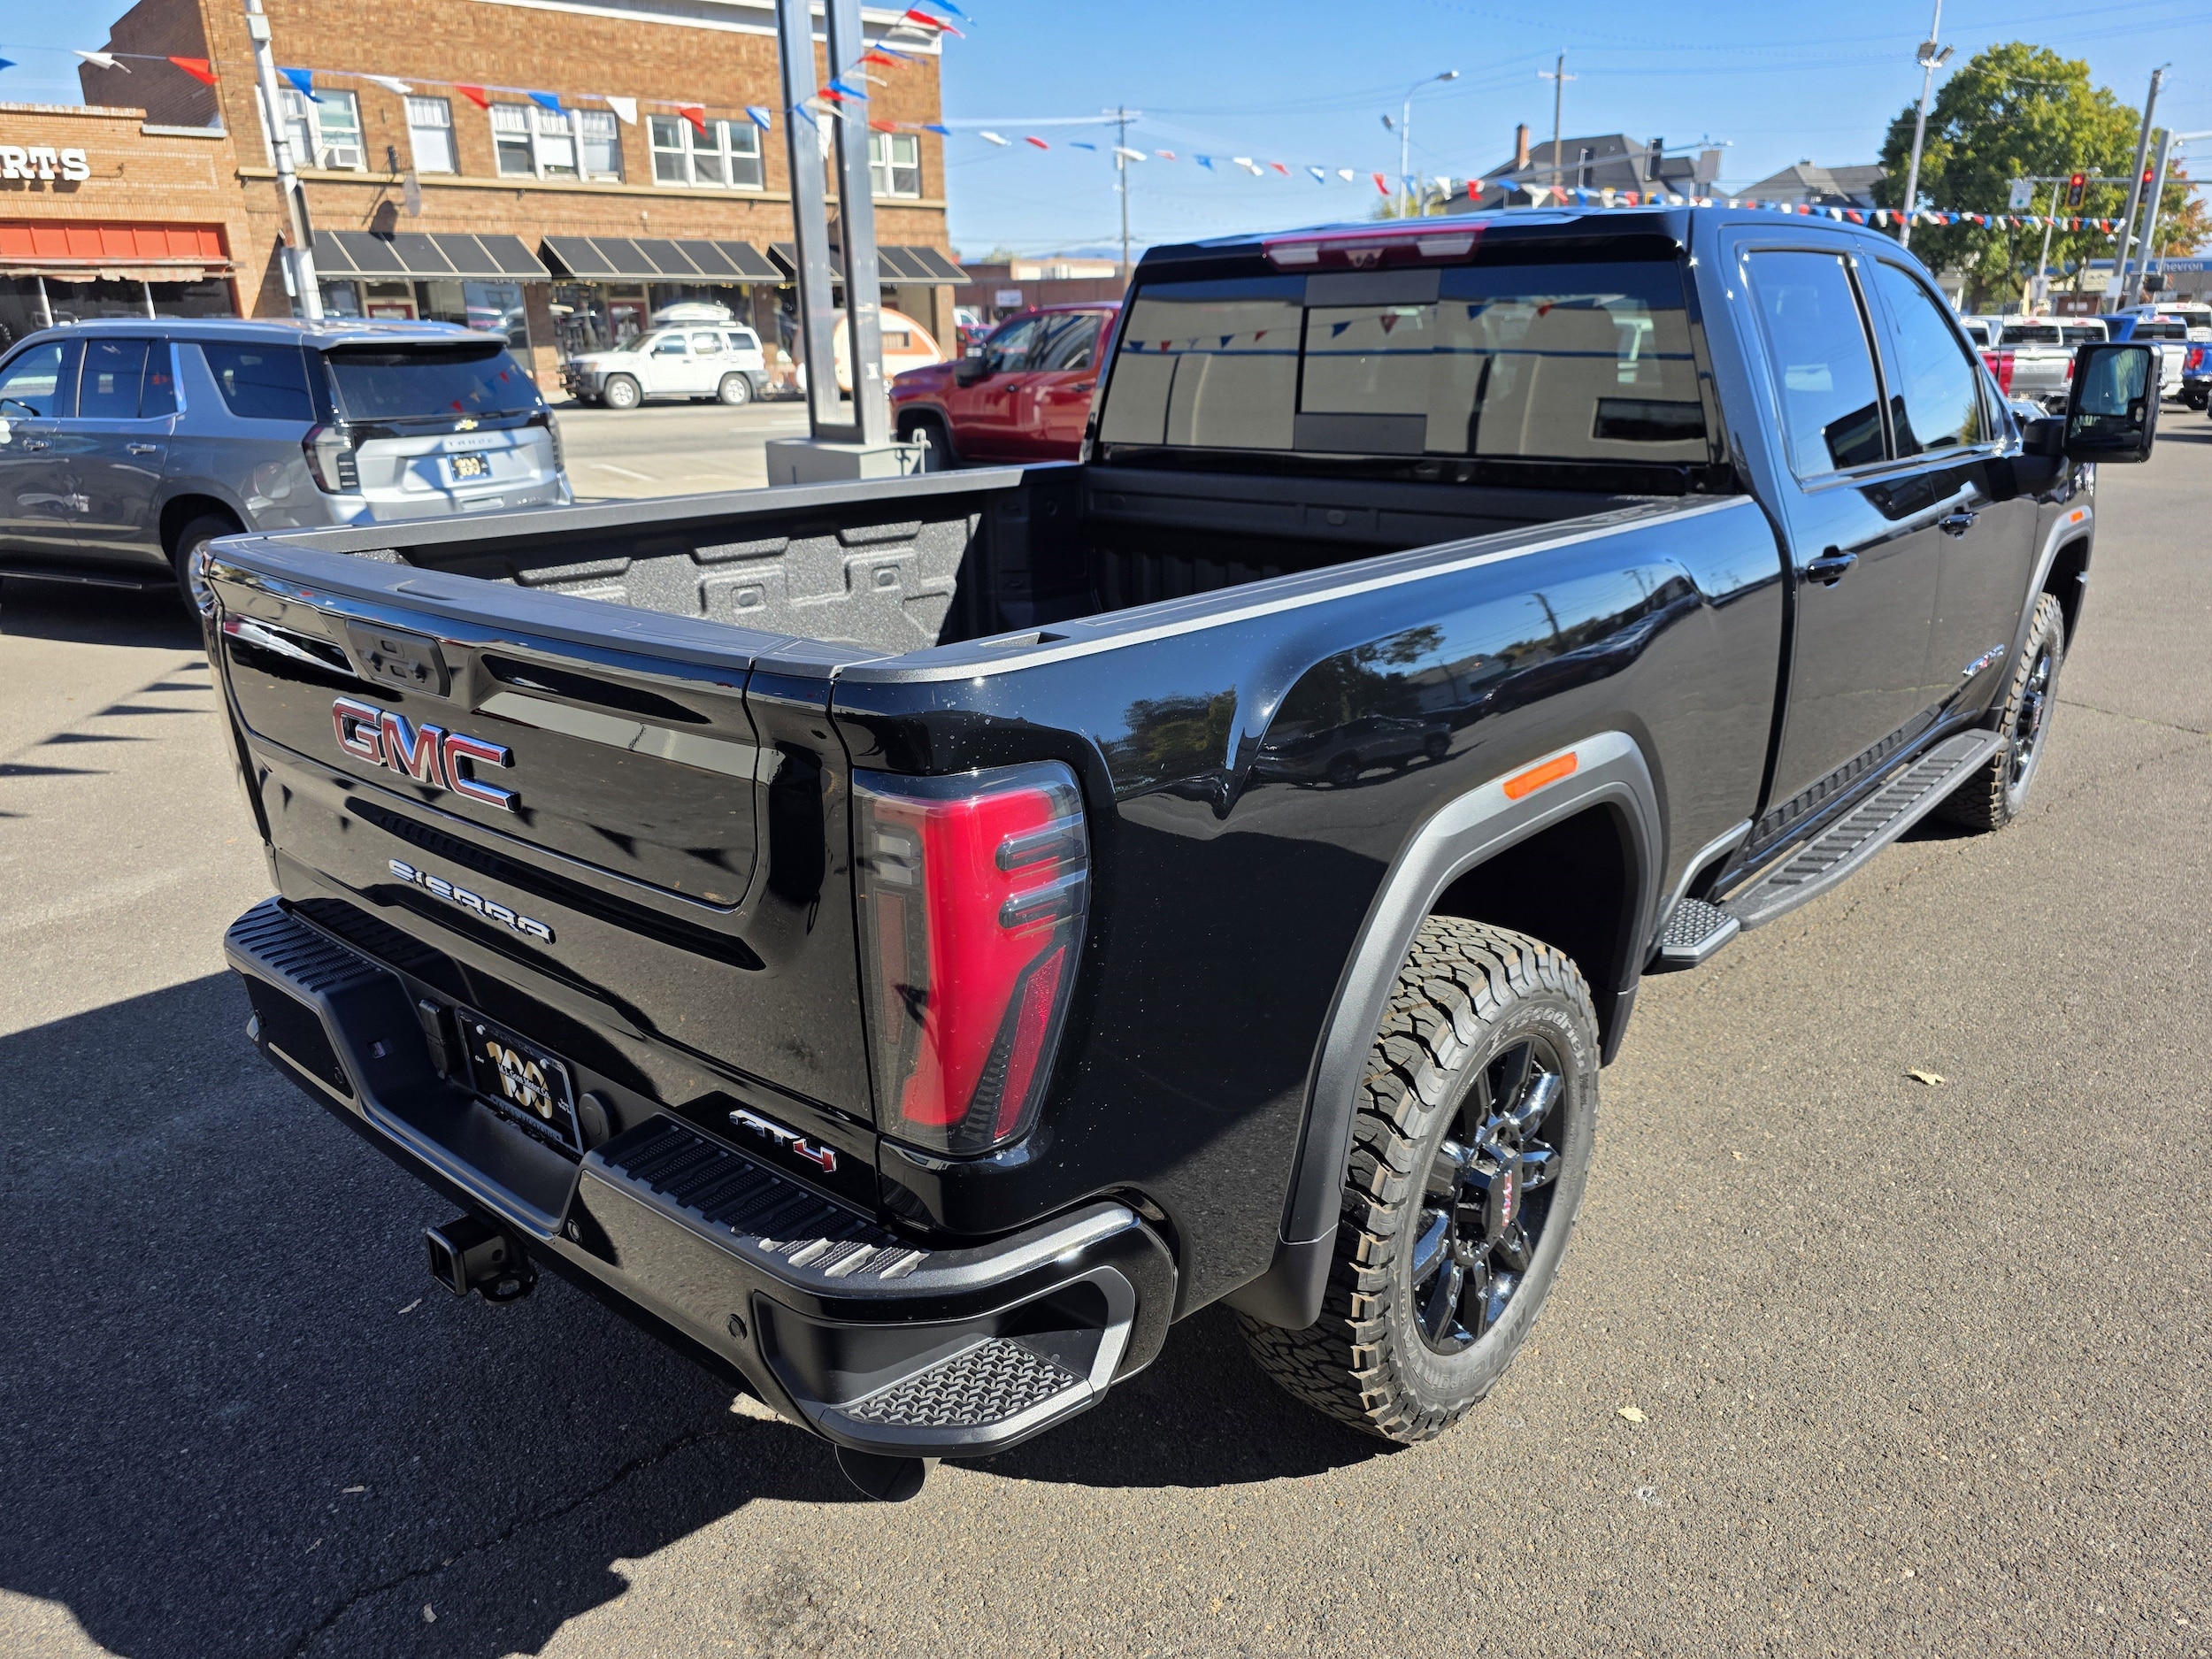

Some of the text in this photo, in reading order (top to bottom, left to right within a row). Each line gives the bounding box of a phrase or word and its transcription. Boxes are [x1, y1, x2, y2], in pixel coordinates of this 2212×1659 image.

[0, 145, 91, 181] RTS
[333, 696, 522, 814] GMC
[388, 858, 557, 945] SIERRA
[486, 1041, 554, 1119] 100
[729, 1108, 838, 1173] AT4
